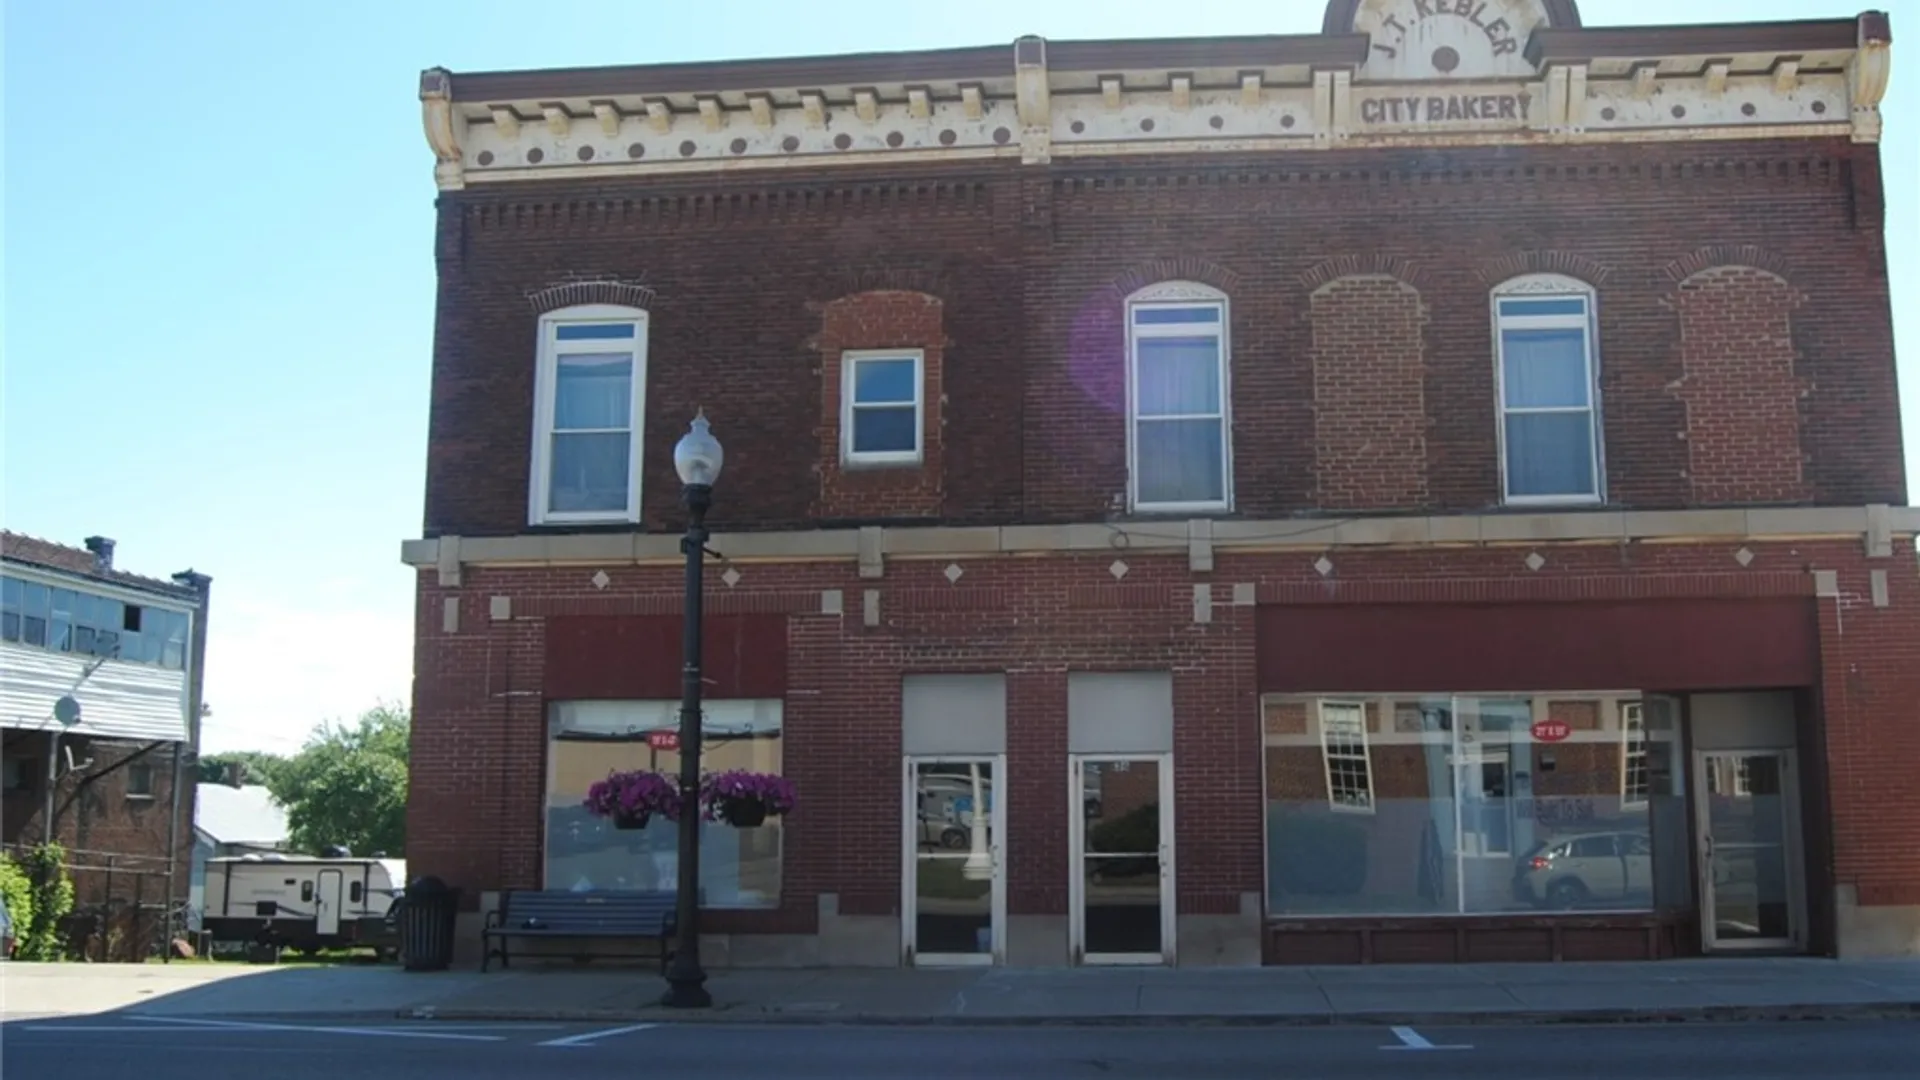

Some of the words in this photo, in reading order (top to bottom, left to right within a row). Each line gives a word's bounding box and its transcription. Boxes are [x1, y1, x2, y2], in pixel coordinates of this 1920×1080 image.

[1412, 0, 1518, 57] KEBLER
[1361, 97, 1420, 123] CITY
[1427, 94, 1532, 121] BAKERY
